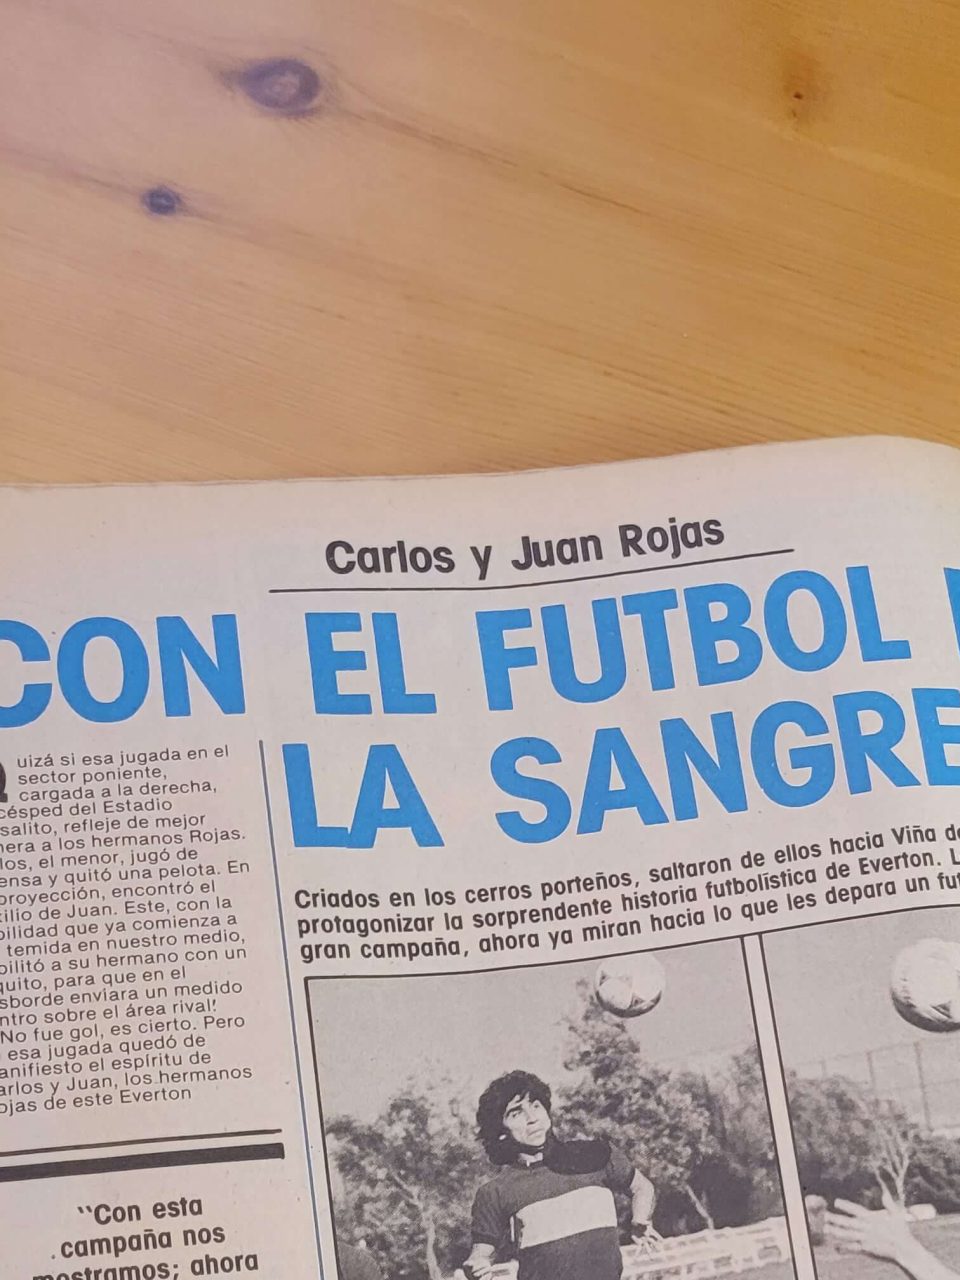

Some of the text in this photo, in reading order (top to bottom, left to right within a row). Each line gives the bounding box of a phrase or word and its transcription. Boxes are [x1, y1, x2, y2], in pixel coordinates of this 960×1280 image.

[325, 516, 725, 581] Carlos y Juan Rojas
[304, 611, 437, 715] EL
[475, 565, 912, 711] FUTBOL
[60, 752, 76, 767] si
[81, 754, 114, 766] esa
[119, 747, 182, 767] jugada
[187, 748, 208, 761] en
[213, 744, 229, 758] el
[281, 743, 445, 849] LA
[294, 888, 380, 910] Criados
[389, 891, 416, 908] en
[424, 887, 457, 907] los
[464, 884, 533, 904] cerros
[540, 871, 640, 902] porteños,
[648, 857, 732, 883] saltaron
[740, 850, 766, 870] de
[774, 843, 822, 865] ellos
[829, 831, 885, 855] hacia
[890, 825, 937, 845] Viña
[297, 913, 435, 939] protagonizar
[443, 912, 464, 931] la
[472, 898, 613, 930] sorprendente
[620, 884, 698, 912] historia
[704, 868, 817, 900] futbolística
[825, 861, 851, 881] de
[858, 851, 942, 876] Everton.
[300, 943, 351, 964] gran
[360, 937, 469, 962] campaña,
[478, 933, 540, 953] ahora
[547, 929, 573, 951] ya
[582, 919, 642, 942] miran
[649, 907, 705, 932] hacia
[713, 904, 732, 923] lo
[740, 899, 779, 922] que
[786, 893, 817, 911] les
[825, 880, 897, 905] depara
[904, 876, 930, 893] un
[60, 1226, 226, 1259] campaña nos
[152, 1196, 203, 1220] esta
[190, 1253, 259, 1277] ahora
